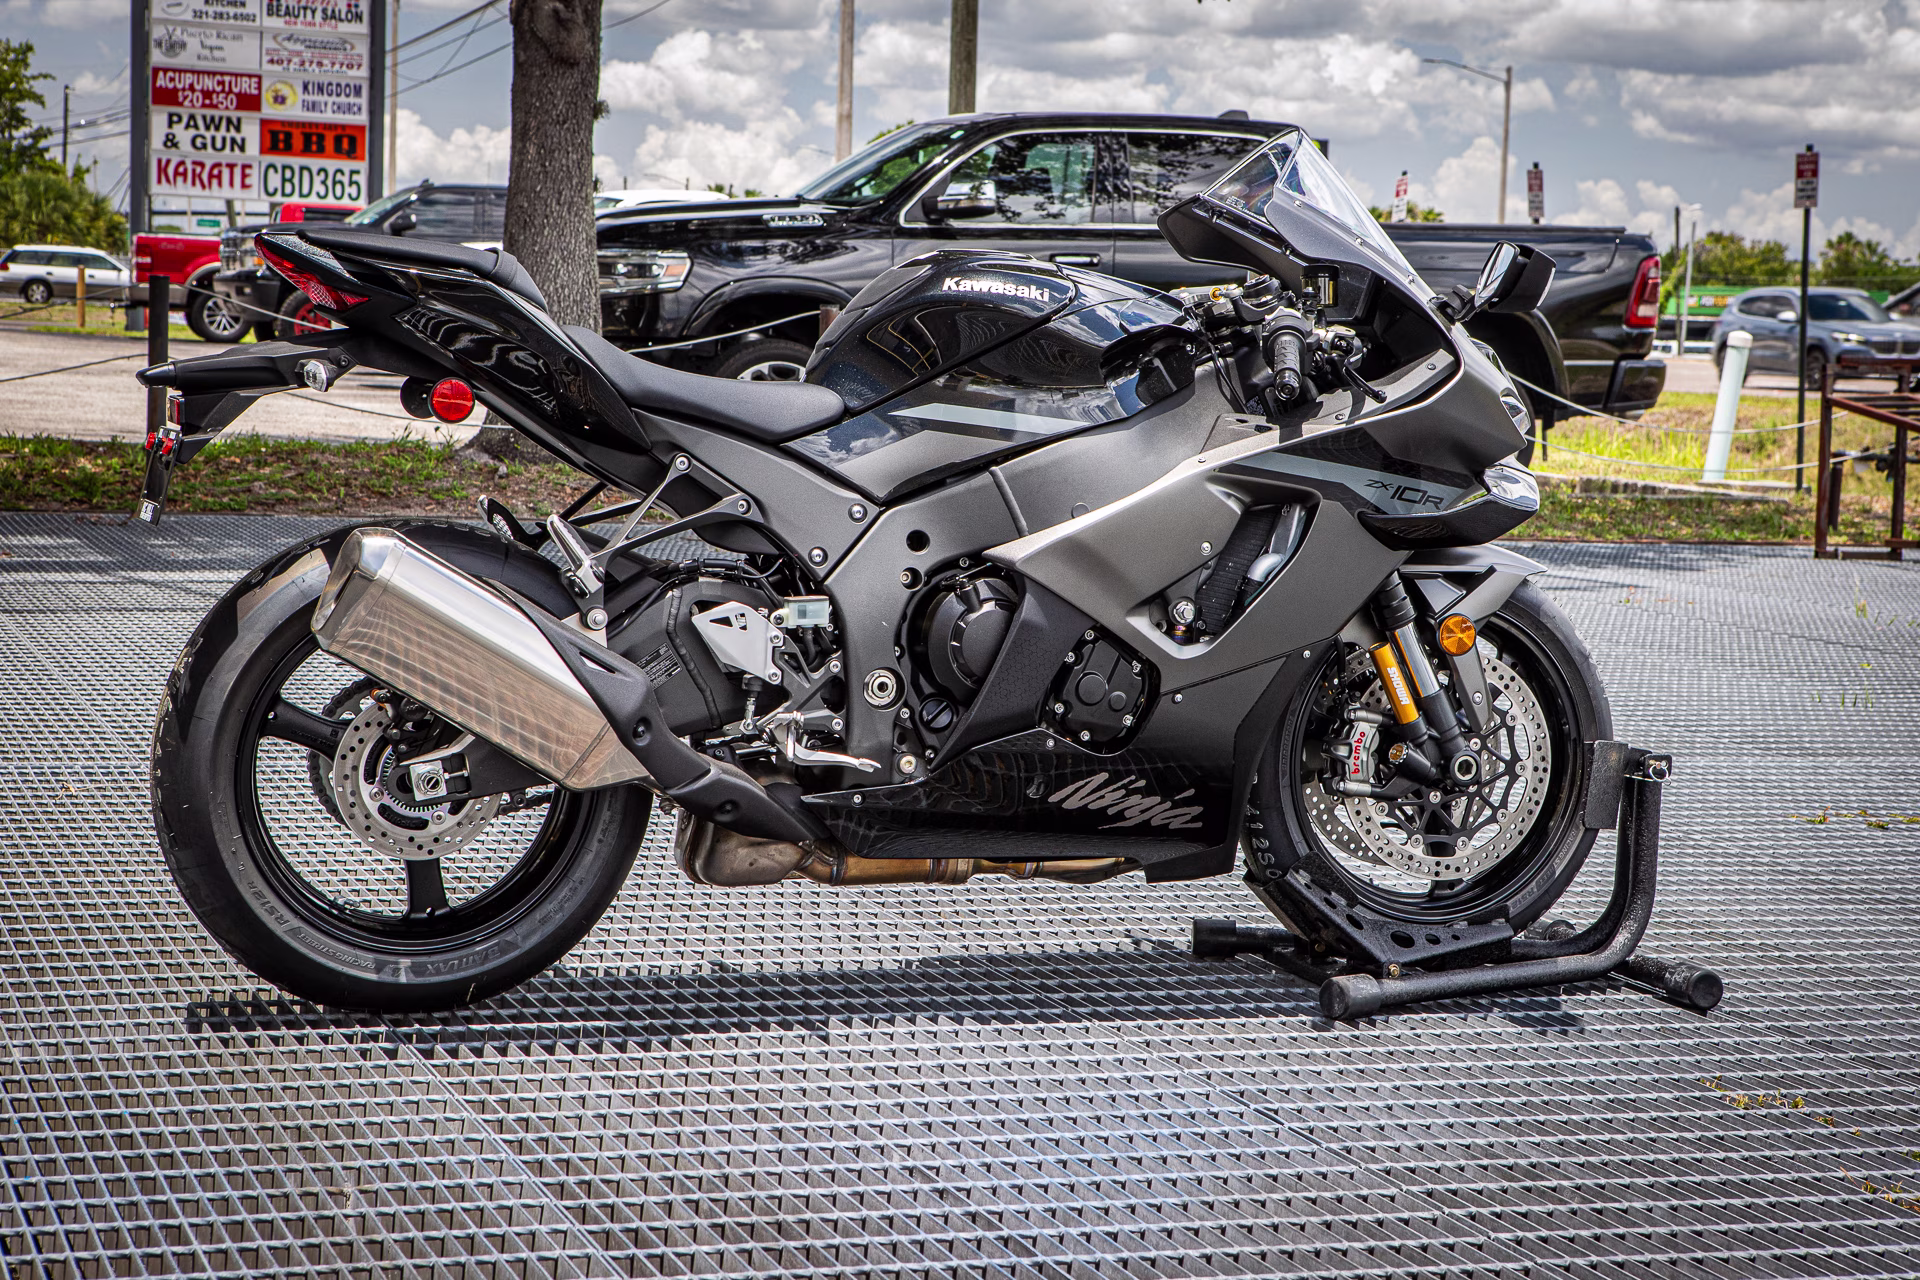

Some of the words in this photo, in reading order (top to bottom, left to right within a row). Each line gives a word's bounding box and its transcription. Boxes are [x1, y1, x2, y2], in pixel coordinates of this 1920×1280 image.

[266, 3, 317, 20] BEAUTY
[321, 7, 363, 24] SALON
[156, 70, 259, 95] ACUPUNCTURE
[302, 80, 363, 98] KINGDOM
[301, 99, 328, 114] FAMILY
[331, 101, 362, 116] CHURCH
[167, 111, 242, 133] PAWN
[163, 132, 180, 150] &
[190, 134, 246, 153] GUN
[156, 157, 253, 191] KARATE
[263, 163, 362, 201] CBD365
[942, 276, 1050, 302] Kawasaki
[1387, 666, 1410, 705] SHOWA
[1351, 731, 1366, 775] brembo
[1048, 772, 1204, 829] Ninja
